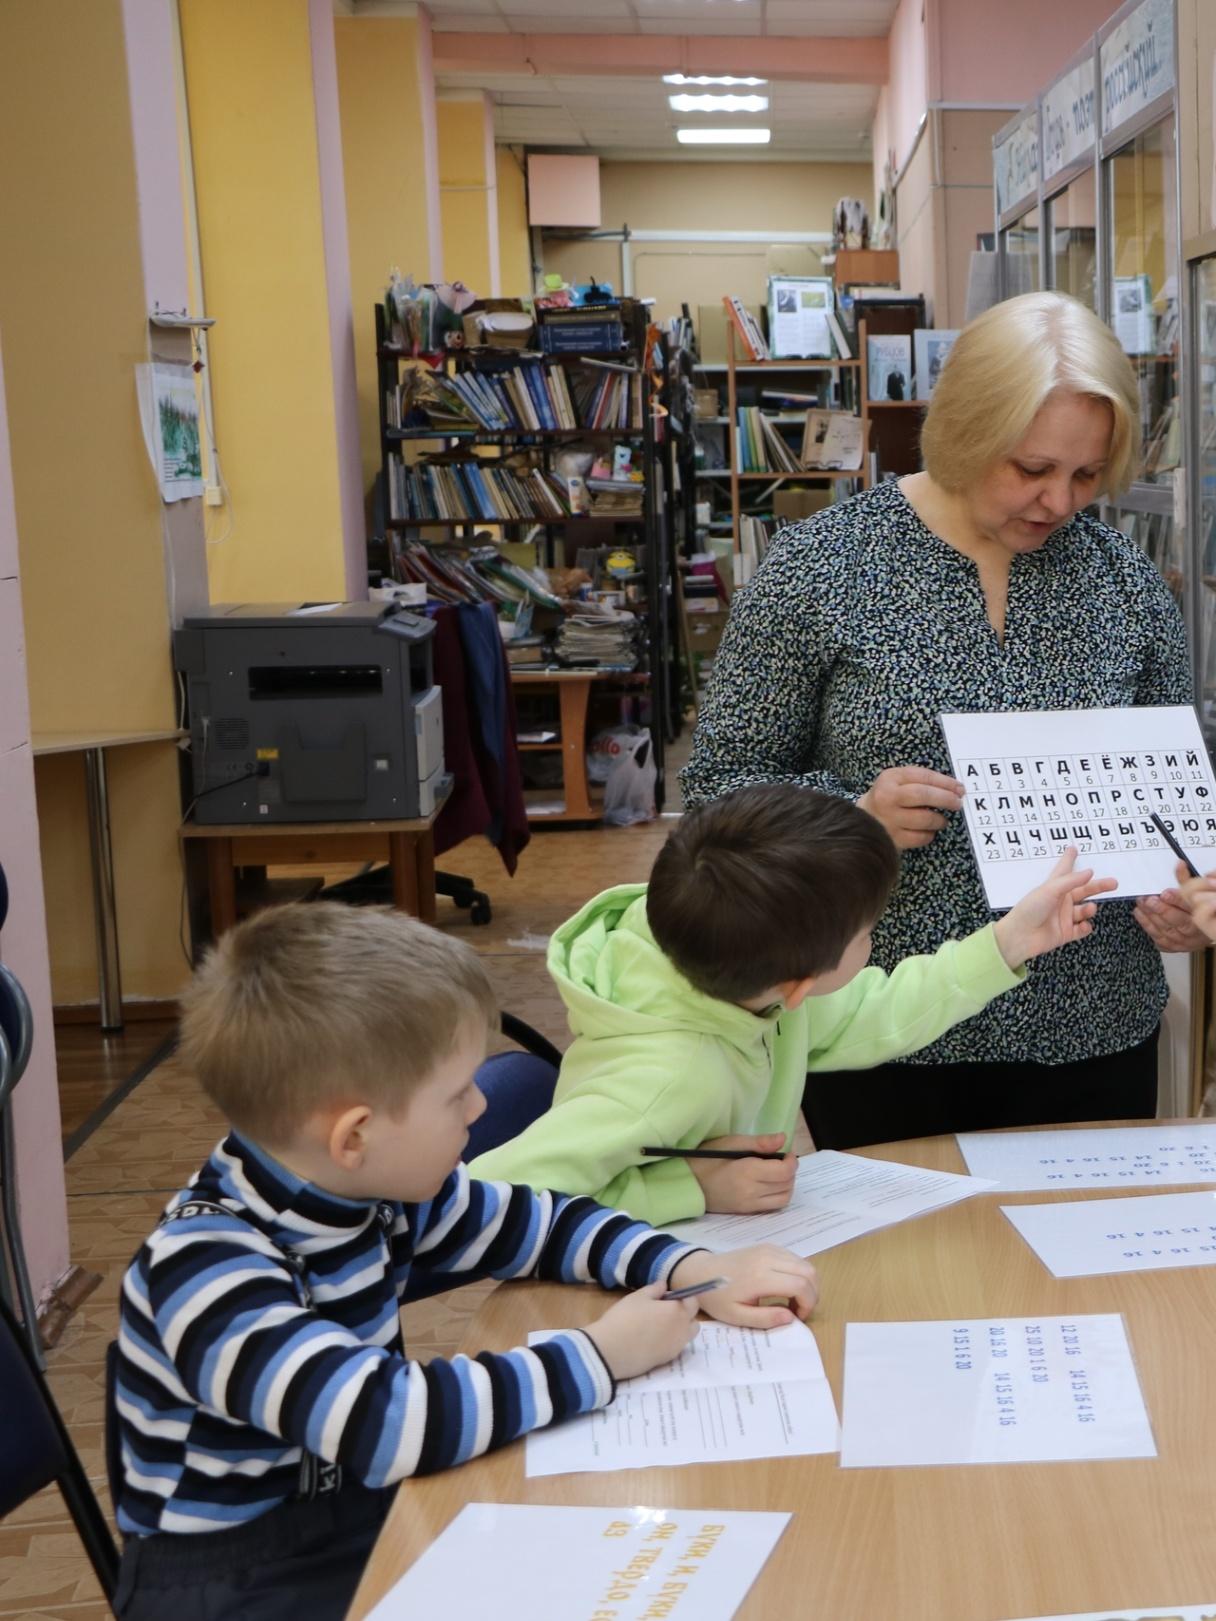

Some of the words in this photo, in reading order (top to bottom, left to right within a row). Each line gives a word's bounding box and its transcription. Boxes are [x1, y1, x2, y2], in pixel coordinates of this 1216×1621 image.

[967, 764, 979, 777] А
[989, 763, 1001, 776] Б
[1011, 762, 1024, 775] В
[1035, 761, 1044, 773] Г
[1057, 760, 1071, 775] Д
[1080, 759, 1091, 771] Е
[1102, 754, 1113, 770] Ё
[1120, 756, 1138, 769] Ж
[1145, 755, 1155, 767] З
[1165, 755, 1178, 767] И
[1186, 750, 1199, 766] Й
[973, 782, 980, 791] 1
[995, 781, 1003, 790] 2
[1018, 780, 1025, 789] 3
[1041, 778, 1048, 787] 4
[1063, 777, 1071, 786] 5
[1086, 776, 1093, 785] 6
[1107, 775, 1114, 783] 7
[1130, 773, 1137, 782] 8
[1151, 770, 1158, 780] 9
[1170, 771, 1183, 780] 10
[1191, 770, 1203, 779] 11
[974, 798, 987, 811] К
[998, 797, 1011, 809] Л
[1019, 796, 1034, 808] М
[1043, 794, 1056, 807] Н
[1065, 793, 1079, 805] О
[1088, 791, 1101, 804] П
[1111, 790, 1121, 802] Р
[1133, 789, 1144, 801] С
[1154, 787, 1164, 800] Т
[1175, 786, 1185, 799] У
[1195, 786, 1209, 798] Ф
[978, 815, 991, 825] 12
[1001, 814, 1015, 824] 13
[1025, 813, 1037, 822] 14
[1047, 811, 1060, 821] 15
[1070, 810, 1083, 819] 16
[1093, 808, 1105, 818] 17
[1115, 807, 1128, 816] 18
[1137, 805, 1149, 814] 19
[1159, 804, 1171, 814] 20
[1179, 803, 1191, 812] 21
[1200, 802, 1212, 811] 22
[983, 832, 996, 845] Х
[1006, 831, 1021, 845] Ц
[1029, 829, 1041, 841] Ч
[1050, 827, 1068, 840] Ш
[1072, 825, 1093, 840] Щ
[1098, 824, 1110, 837] Ь
[1118, 822, 1135, 835] Ы
[1140, 821, 1155, 834] Ъ
[1164, 820, 1175, 833] Э
[1182, 819, 1199, 832] Ю
[1206, 818, 1216, 831] Я
[987, 850, 1000, 859] 23
[1010, 848, 1024, 858] 24
[1033, 846, 1047, 856] 25
[1080, 843, 1092, 852] 27
[1102, 841, 1116, 851] 28
[1125, 840, 1137, 849] 29
[1146, 838, 1159, 847] 30
[1188, 836, 1201, 845] 32
[989, 1327, 1005, 1335] 20
[1024, 1326, 1041, 1334] 25
[1060, 1325, 1077, 1333] 12
[953, 1336, 970, 1344] 15
[1026, 1337, 1043, 1345] 10
[1062, 1336, 1079, 1344] 20
[991, 1349, 1008, 1358] 20
[1028, 1348, 1045, 1356] 20
[1065, 1347, 1082, 1355] 16
[955, 1361, 973, 1370] 20
[994, 1373, 1011, 1381] 14
[1032, 1374, 1049, 1382] 20
[1069, 1370, 1086, 1378] 14
[995, 1384, 1012, 1393] 15
[1071, 1381, 1088, 1390] 15
[996, 1396, 1014, 1404] 16
[1073, 1394, 1091, 1402] 16
[999, 1416, 1017, 1426] 16
[1077, 1413, 1095, 1422] 16
